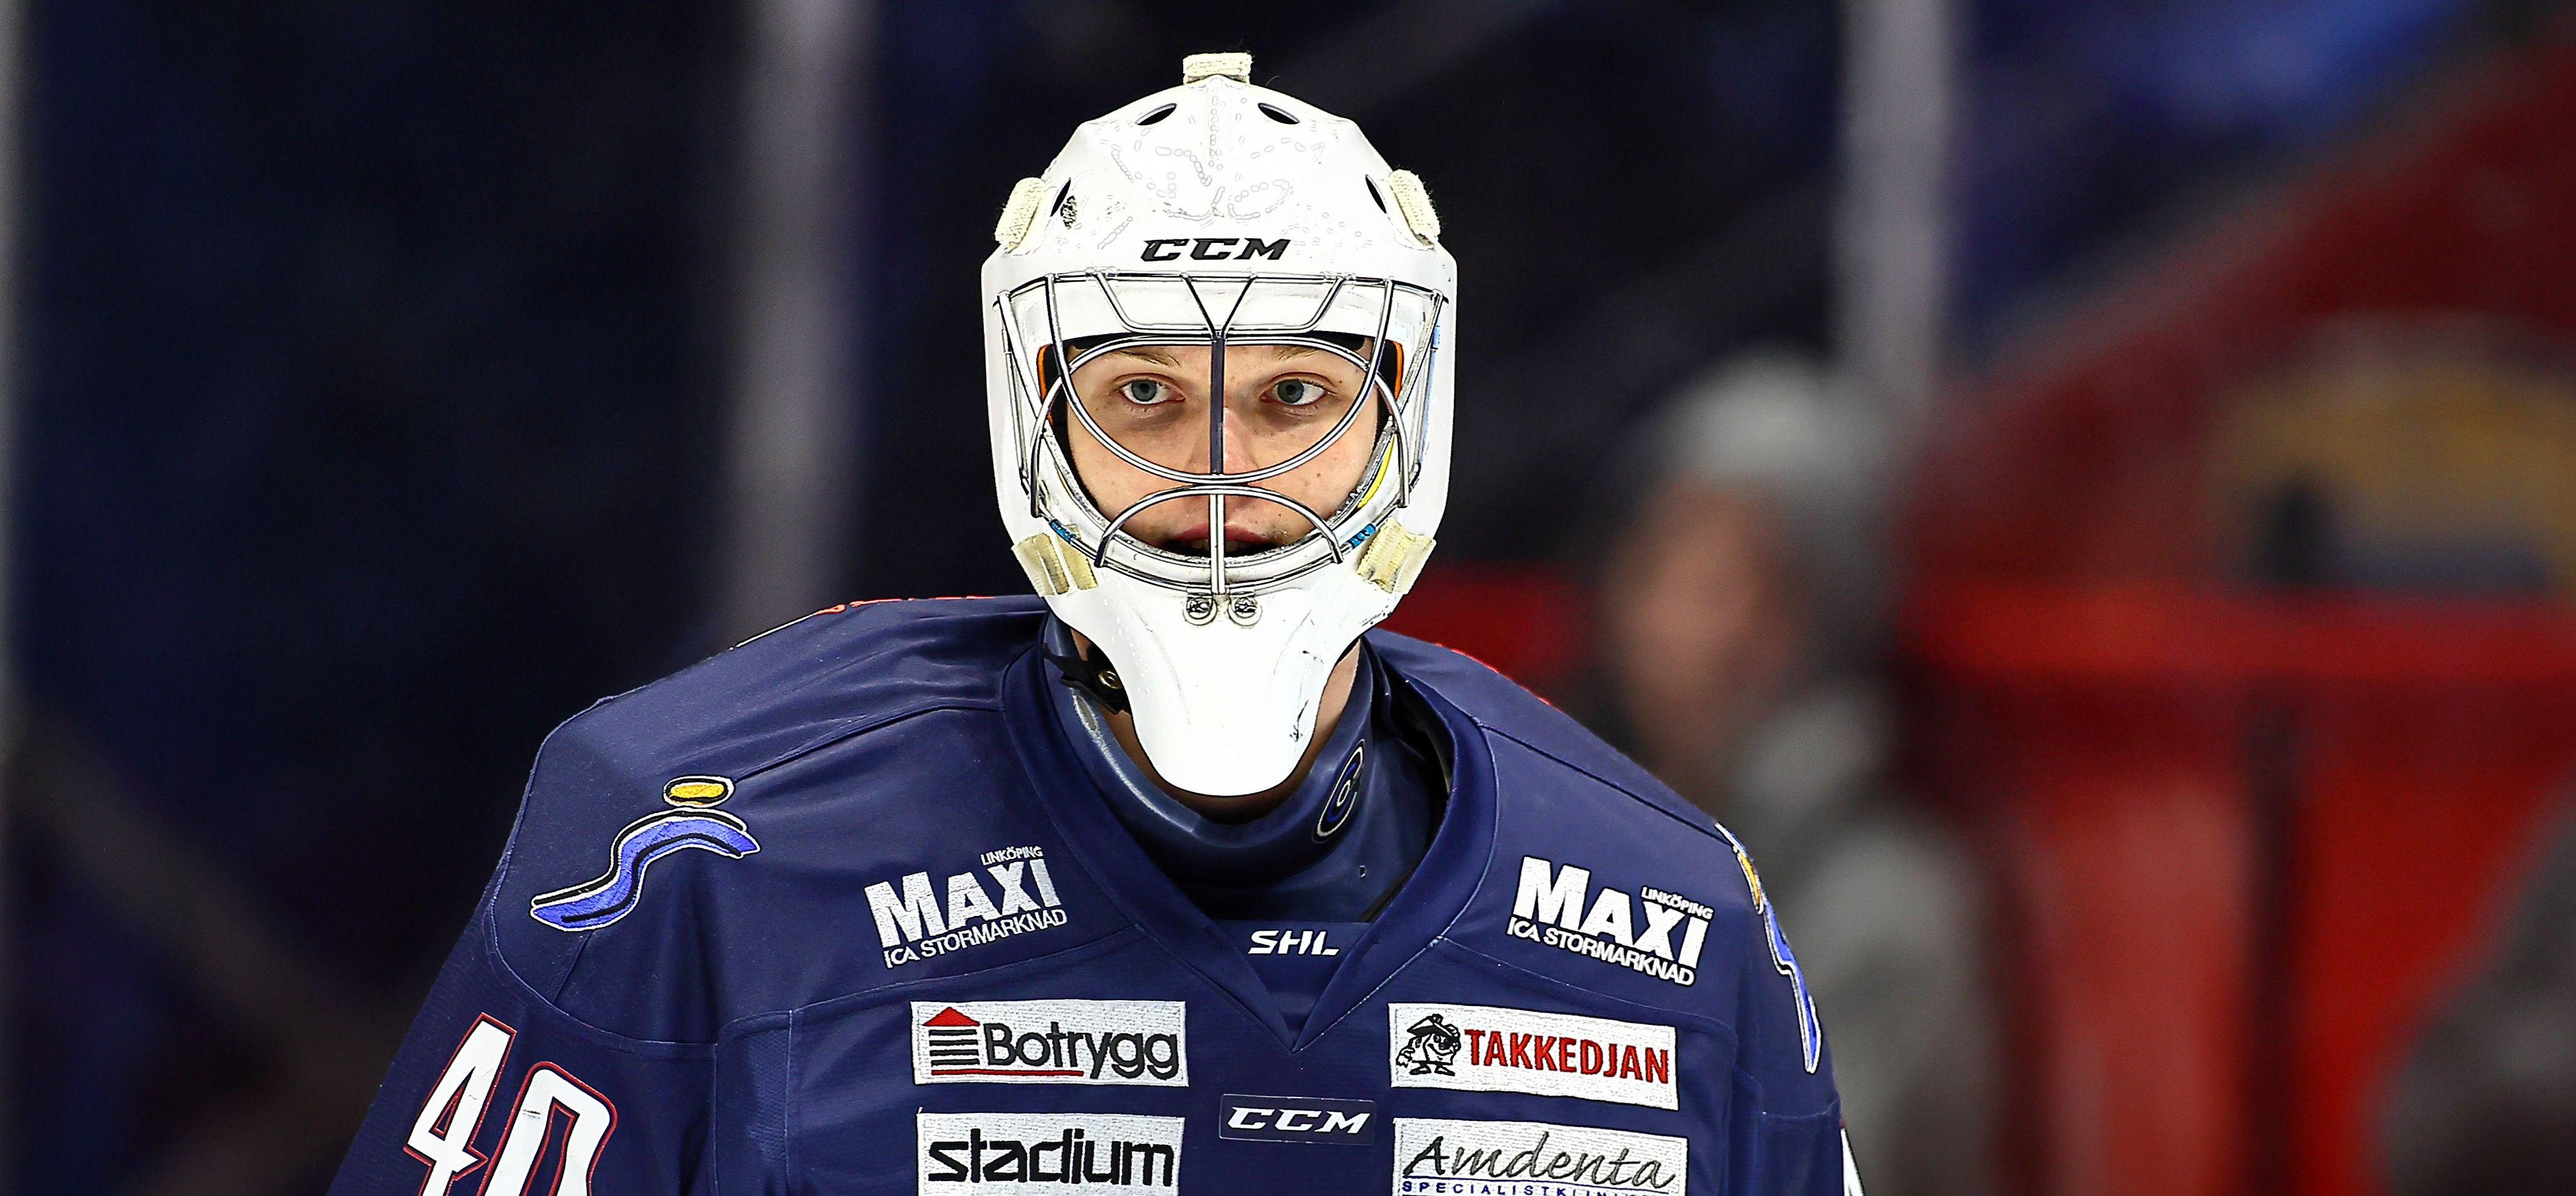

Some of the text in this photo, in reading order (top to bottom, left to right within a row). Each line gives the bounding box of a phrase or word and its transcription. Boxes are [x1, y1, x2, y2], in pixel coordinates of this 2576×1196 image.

[1141, 237, 1292, 262] CCM
[980, 845, 1045, 866] LINKÖPING
[864, 858, 1062, 948] MAXI
[1512, 856, 1709, 969] MAXI
[1641, 886, 1714, 920] LINKÖPING
[882, 908, 1068, 969] ICA STORMARKNAD
[1248, 930, 1340, 956] SHL
[1506, 916, 1695, 987] ICA STORMARKNAD
[983, 1021, 1180, 1081] Botrygg
[1464, 1029, 1670, 1084] TAKKEDJAN
[403, 1013, 618, 1196] 40
[1227, 1106, 1371, 1135] CCM
[928, 1128, 1175, 1187] stadium
[1401, 1131, 1677, 1189] Amdenta
